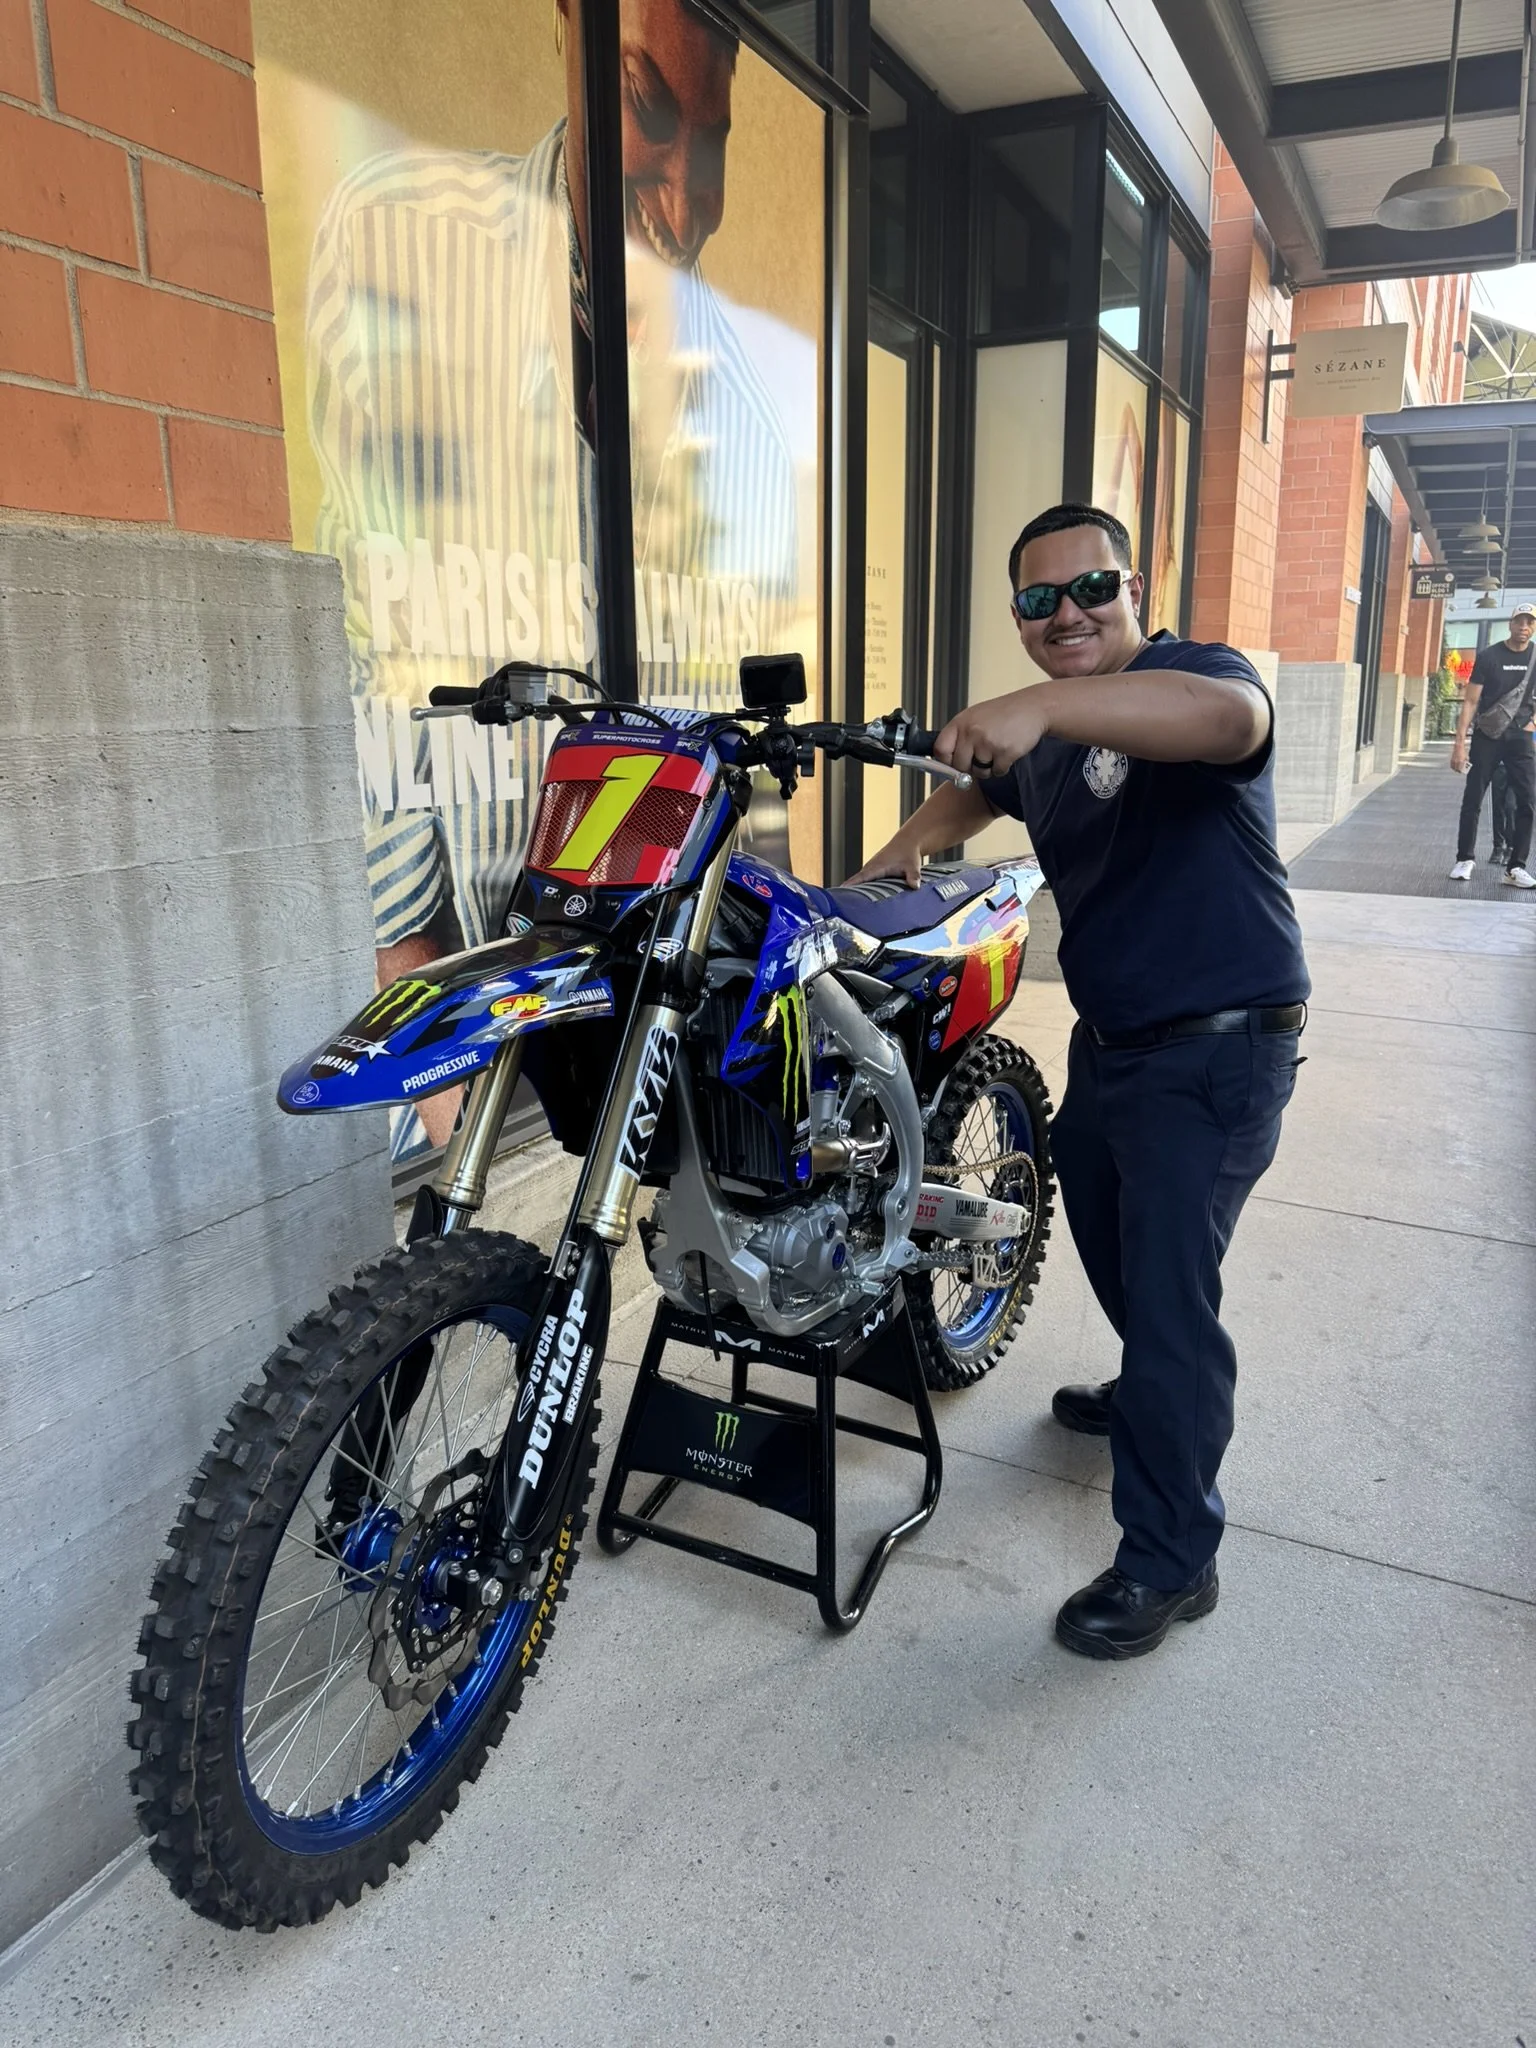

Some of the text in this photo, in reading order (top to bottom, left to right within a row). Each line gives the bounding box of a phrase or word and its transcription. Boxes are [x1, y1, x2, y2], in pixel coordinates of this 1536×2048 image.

[1314, 359, 1386, 374] SÉZANE
[867, 566, 886, 579] ZANE
[367, 530, 541, 661] PARIS
[547, 558, 598, 665] IS
[592, 735, 661, 744] SUPERMOTOCROSS
[352, 695, 524, 811] NLINE
[545, 753, 668, 871] 1
[936, 879, 970, 900] YAMAHA
[493, 996, 548, 1017] FMF
[577, 987, 609, 1004] YAMAHA
[314, 1055, 360, 1077] AMAHA
[402, 1050, 480, 1093] PROGRESSIVE
[919, 1193, 944, 1204] RAKING
[956, 1200, 988, 1218] YAMALUBE
[917, 1204, 937, 1218] DID
[529, 1314, 559, 1384] CYCRA
[670, 1321, 707, 1335] MATRIX
[768, 1346, 806, 1360] MATRIX
[518, 1288, 588, 1490] DUNLOP
[563, 1344, 593, 1425] BRAKING
[685, 1447, 753, 1478] MONSTER
[693, 1464, 742, 1483] ENERGY
[521, 1527, 571, 1669] DUNLOP
